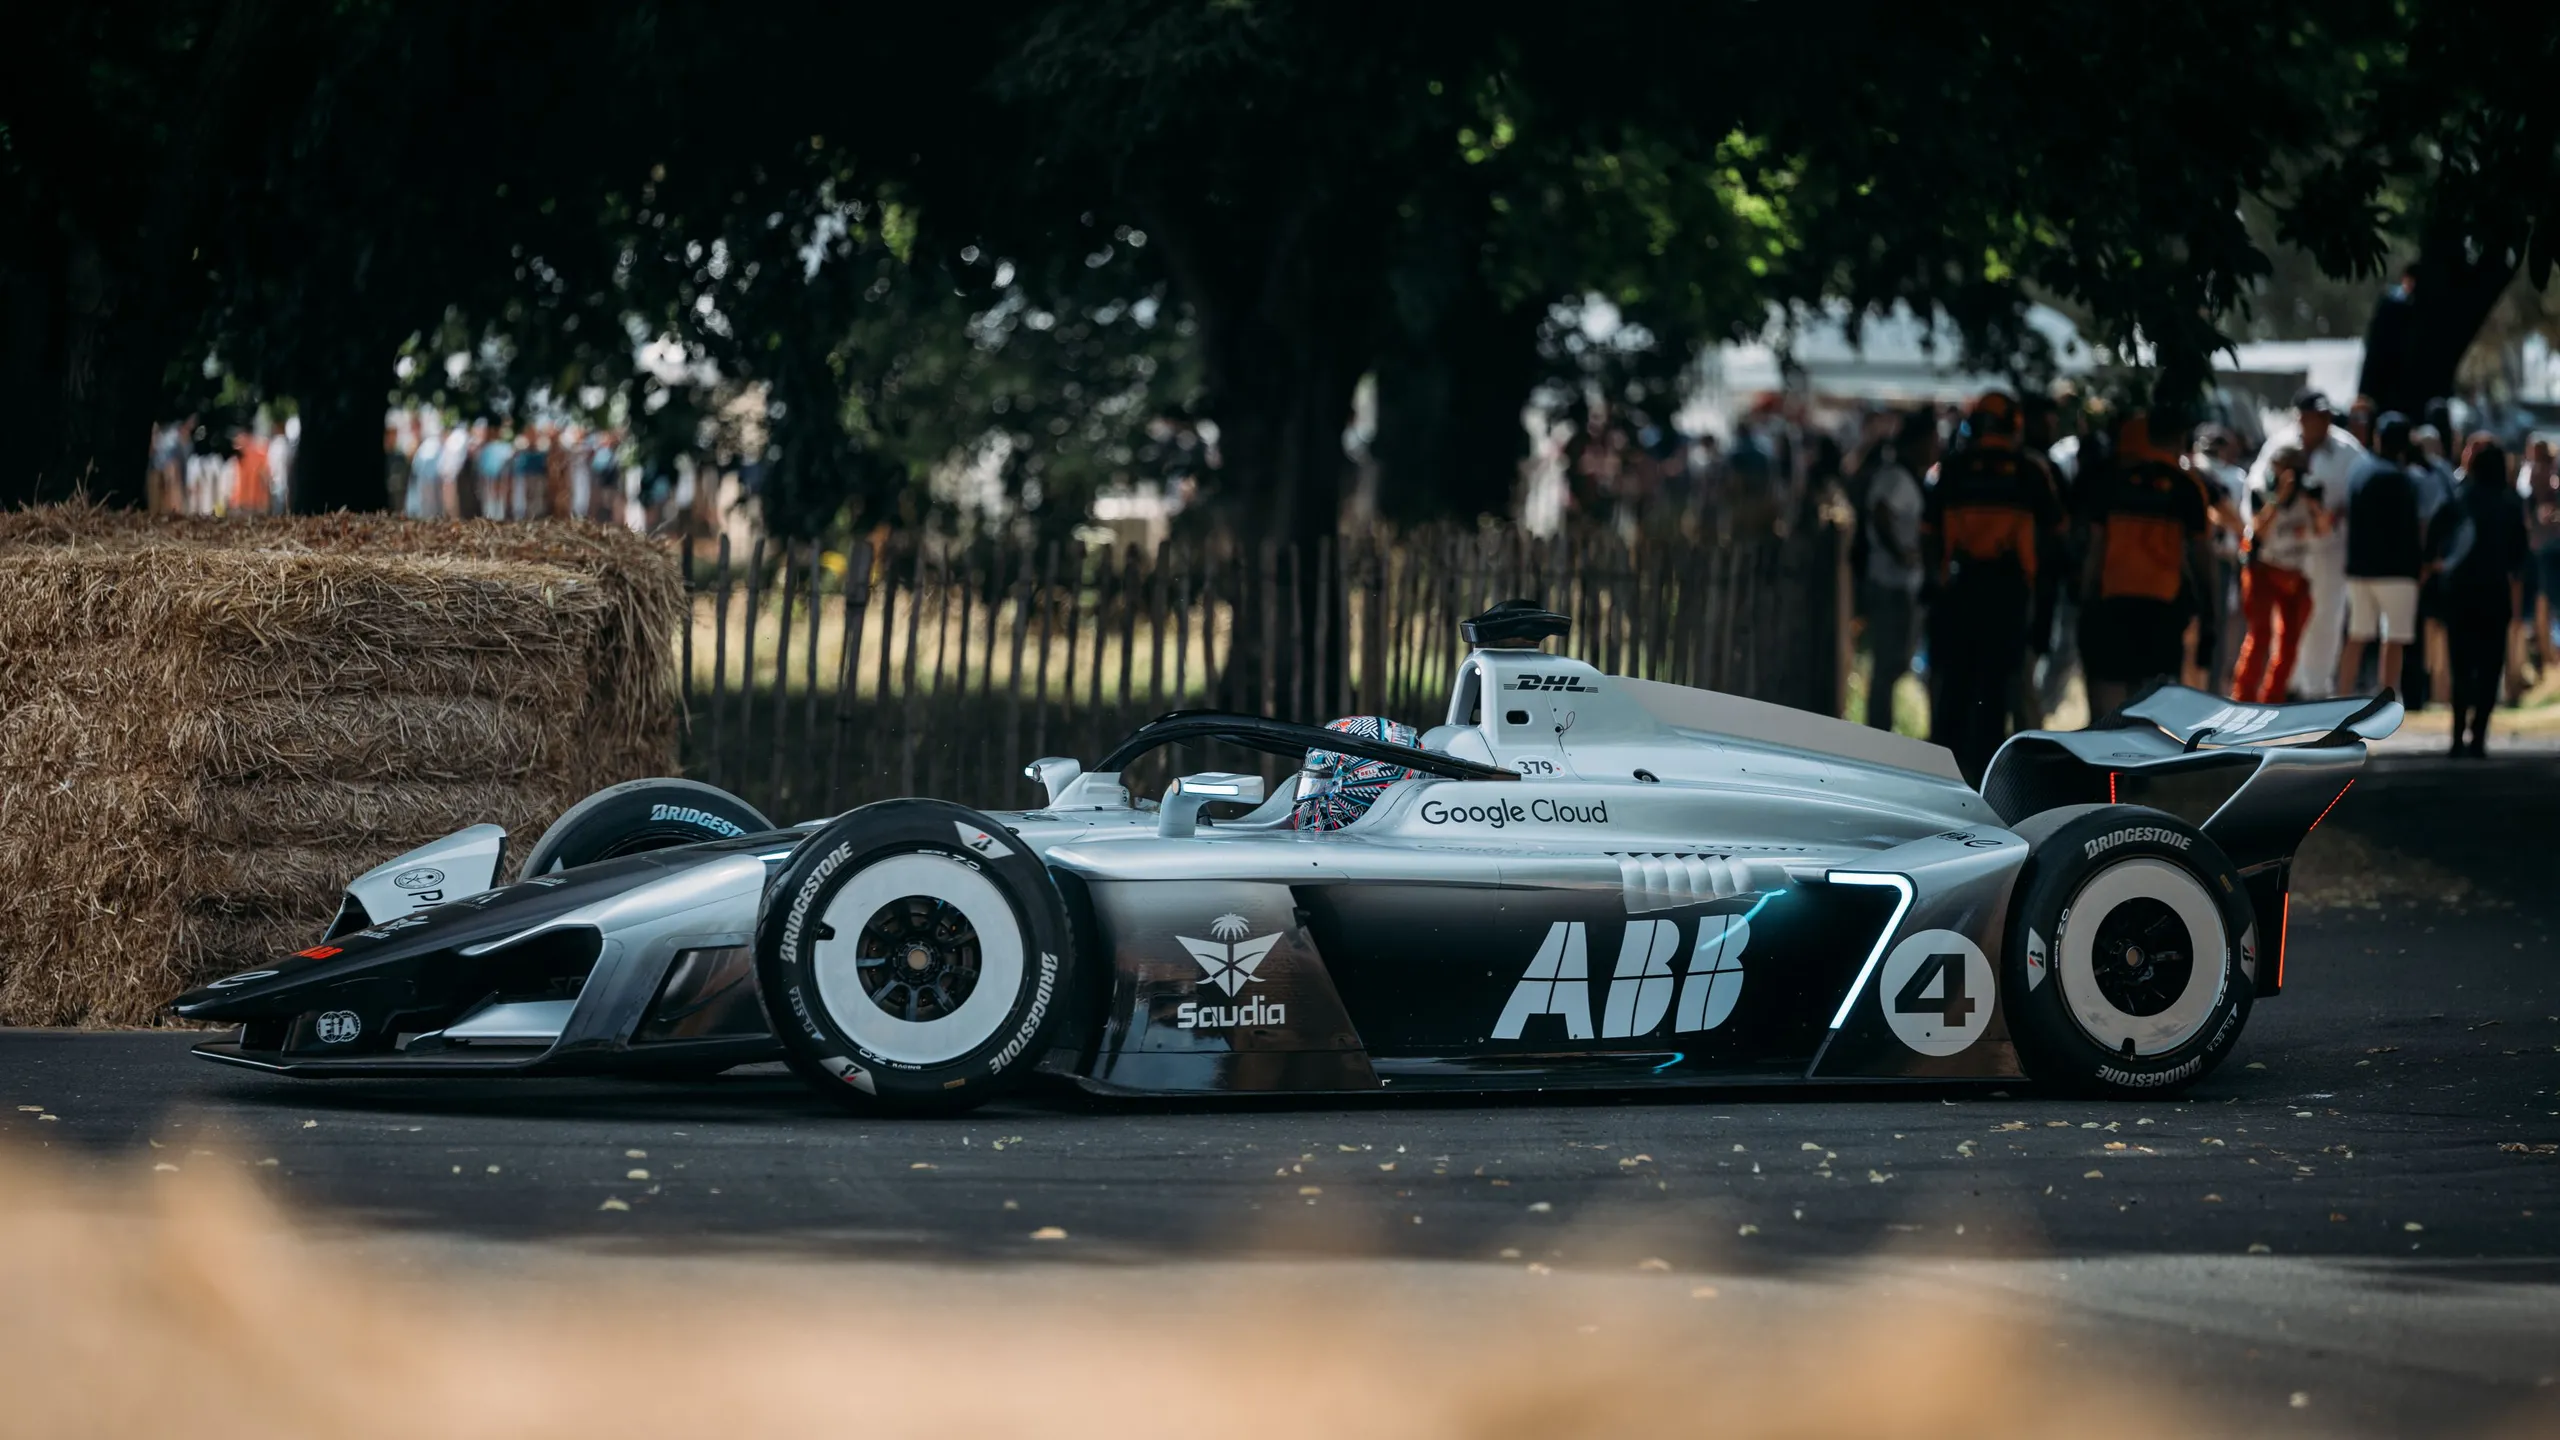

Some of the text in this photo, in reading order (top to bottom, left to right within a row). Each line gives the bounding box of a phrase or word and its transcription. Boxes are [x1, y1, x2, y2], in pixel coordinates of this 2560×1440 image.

[1516, 674, 1587, 693] DHL
[2186, 706, 2280, 735] ABB
[1359, 768, 1377, 777] BELL
[1518, 760, 1554, 775] 379
[650, 804, 747, 837] BRIDGEST
[1421, 798, 1609, 829] Google Cloud
[2084, 827, 2192, 860] BRIDGESTONE
[408, 889, 447, 914] PI
[779, 841, 854, 964] BRIDGESTONE
[1490, 913, 1751, 1040] ABB
[1894, 953, 1975, 1028] 4
[989, 951, 1059, 1075] BRIDGESTONE
[1177, 995, 1286, 1029] Saudia
[2095, 1054, 2201, 1088] BRIDGESTONE
